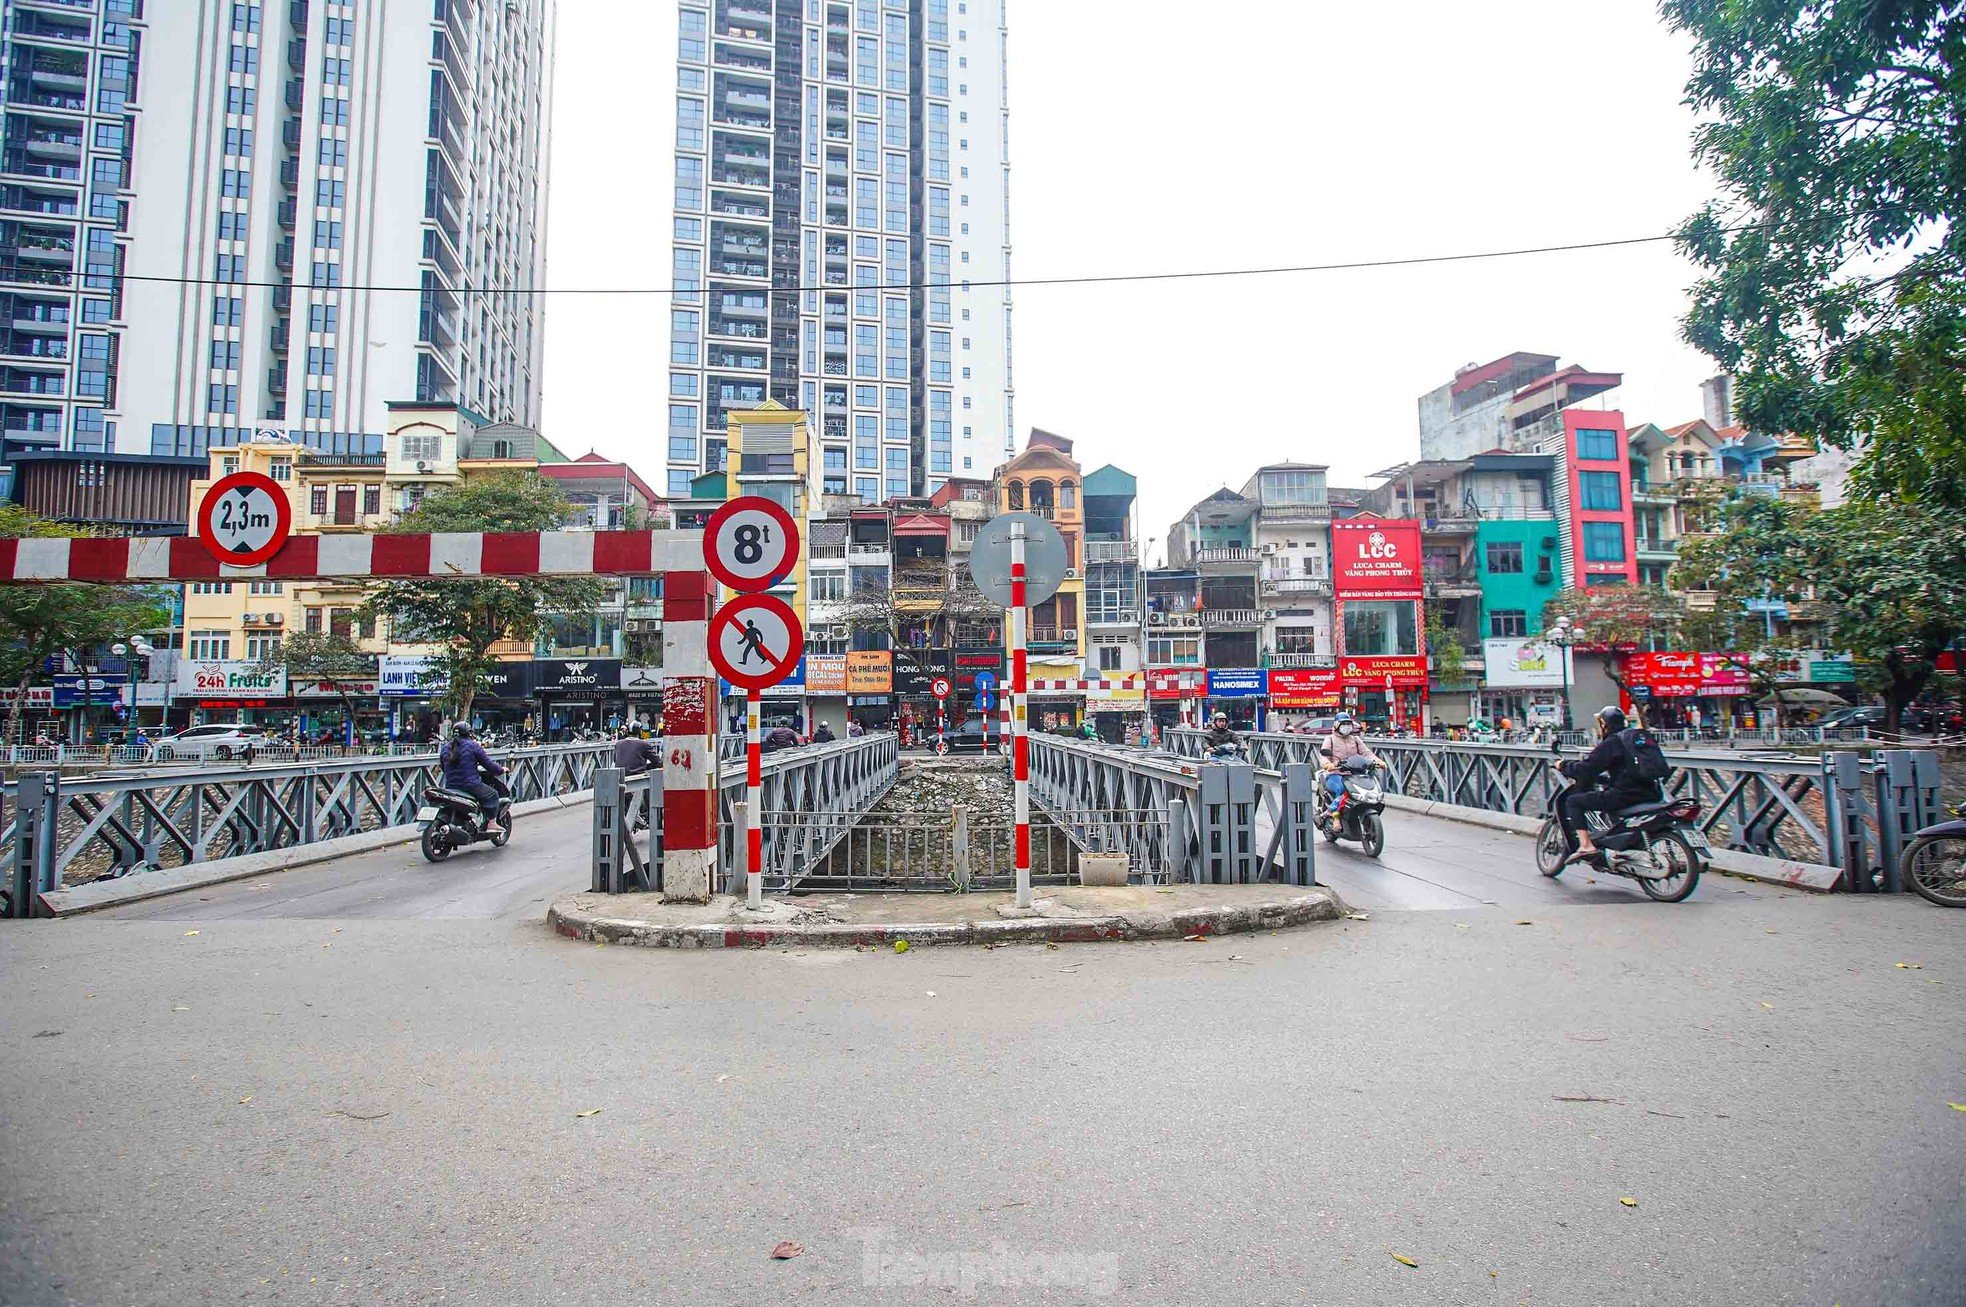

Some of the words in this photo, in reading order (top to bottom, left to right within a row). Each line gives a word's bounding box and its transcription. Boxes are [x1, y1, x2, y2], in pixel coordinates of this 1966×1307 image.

[220, 500, 269, 537] 2,3m
[1358, 543, 1397, 559] LCC
[896, 665, 920, 673] HONG
[1342, 668, 1362, 677] LCC
[197, 676, 225, 688] 24h
[383, 672, 403, 684] LANH
[558, 676, 596, 684] ARISTINO
[1213, 680, 1260, 689] HANOSIMEX
[566, 691, 607, 699] ARISTINO
